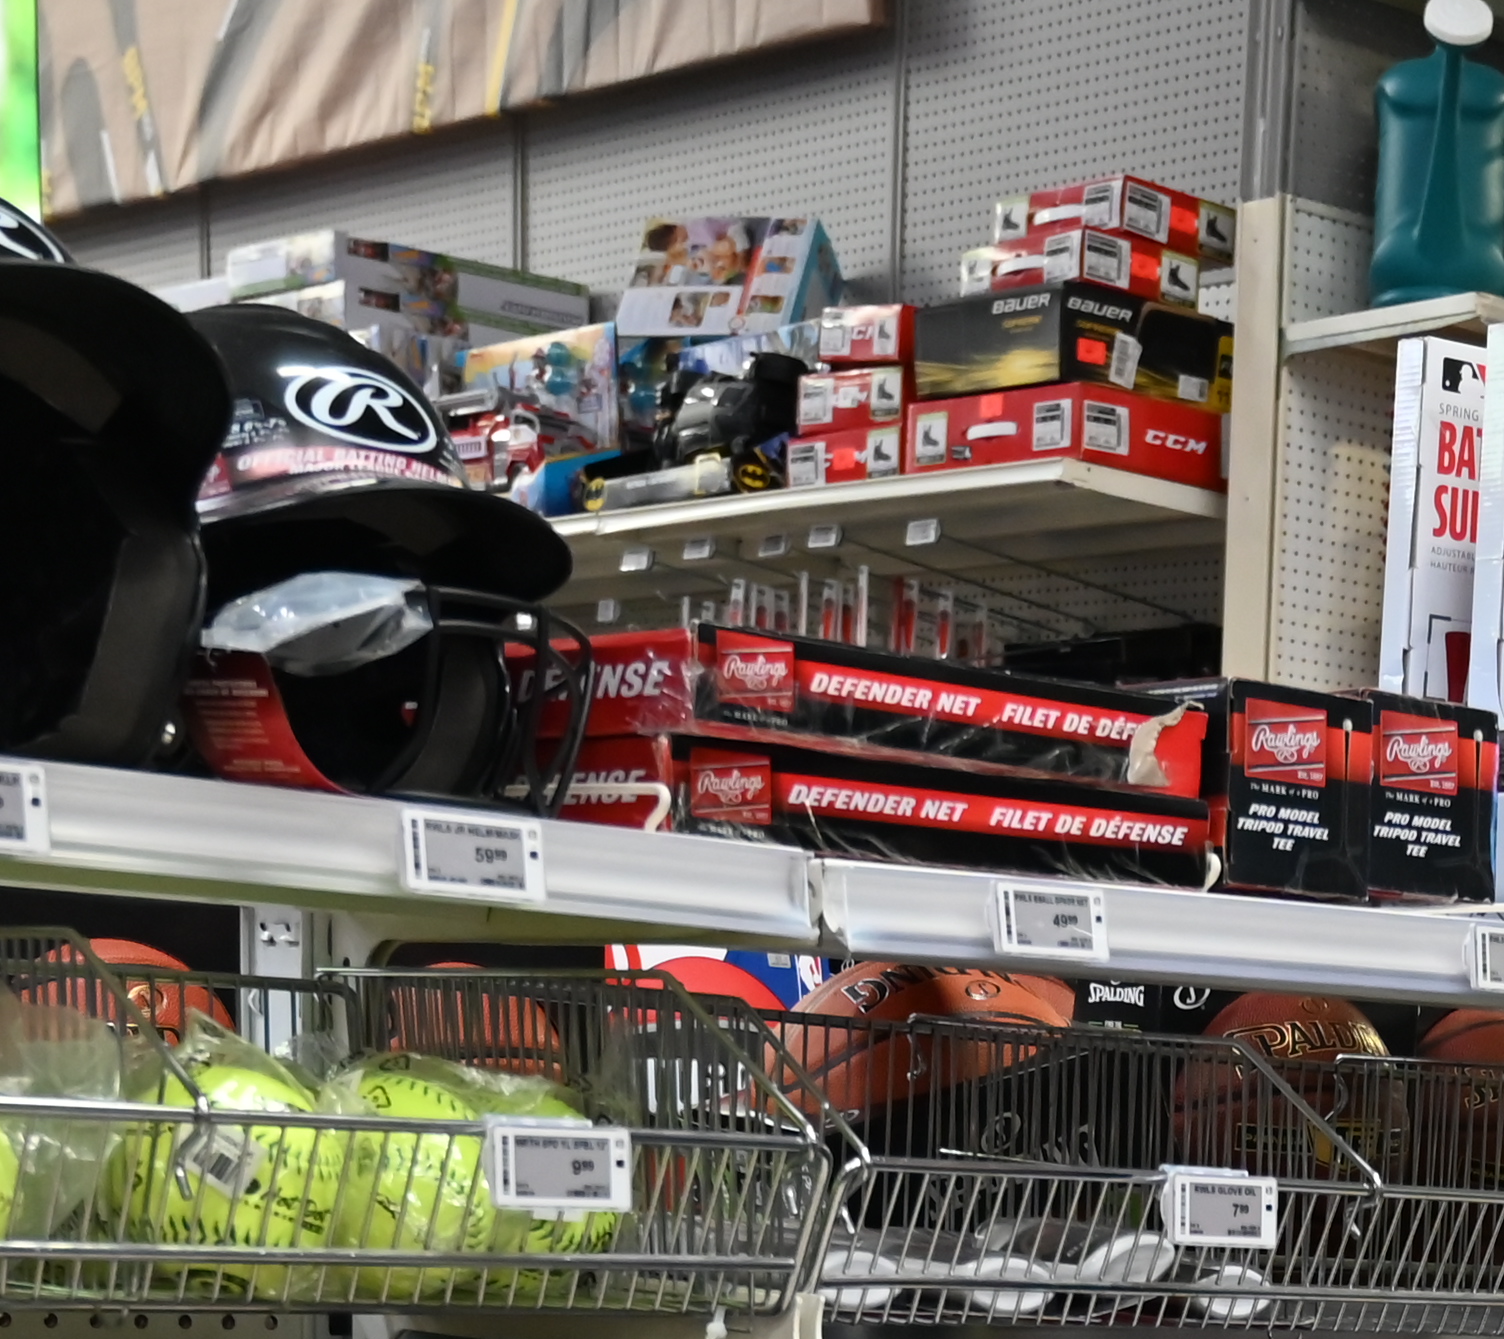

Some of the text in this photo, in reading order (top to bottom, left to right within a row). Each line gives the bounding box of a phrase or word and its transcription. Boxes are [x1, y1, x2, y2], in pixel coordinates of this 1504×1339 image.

[992, 293, 1051, 316] BAUER
[1067, 295, 1134, 322] BAUER
[1439, 403, 1480, 423] SPRING
[1145, 428, 1209, 456] CCM
[723, 654, 788, 687] Rawlings
[809, 670, 932, 710] DEFENDER
[935, 690, 982, 718] NET
[1001, 702, 1062, 730] FILET
[1063, 711, 1100, 735] DE
[1251, 723, 1321, 759] Rawlings
[1386, 734, 1453, 768] Rawlings
[698, 770, 765, 803] Rawlings
[1261, 783, 1287, 796] MARK
[788, 782, 1188, 848] DEFENDER NET FILET DE DÉFENSE
[1248, 803, 1320, 824] PRO MODEL
[1236, 816, 1329, 841] TRIPOD TRAVEL
[1271, 836, 1295, 852] TEE
[1088, 983, 1145, 1007] SPALDING
[1214, 1184, 1244, 1198] GLOVE
[1244, 1185, 1258, 1198] OIL
